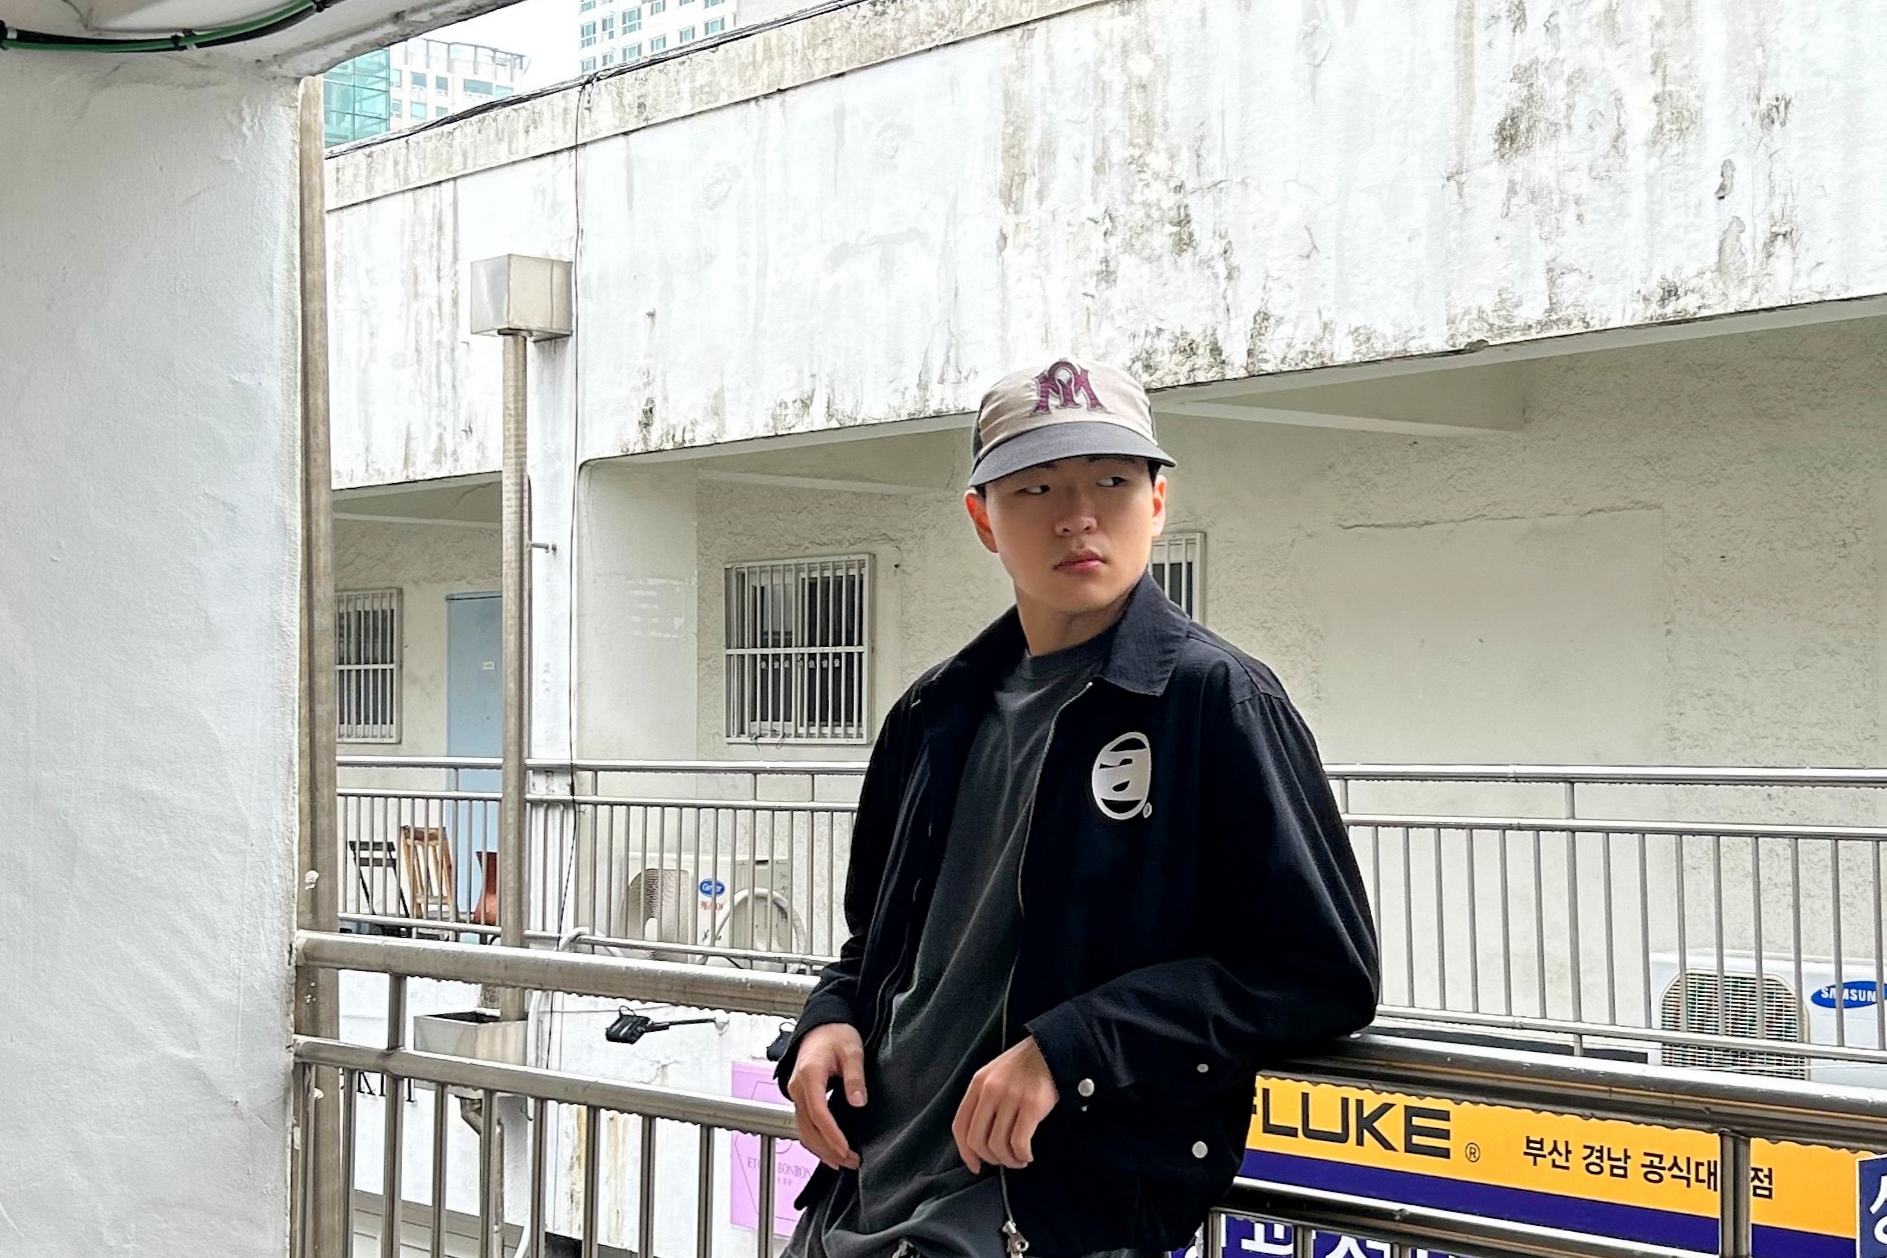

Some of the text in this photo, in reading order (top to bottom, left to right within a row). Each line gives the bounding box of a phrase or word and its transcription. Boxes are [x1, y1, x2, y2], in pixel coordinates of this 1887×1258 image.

[1252, 1087, 1451, 1160] LUKE
[1523, 1135, 1774, 1200] 부산 경남 공식대점
